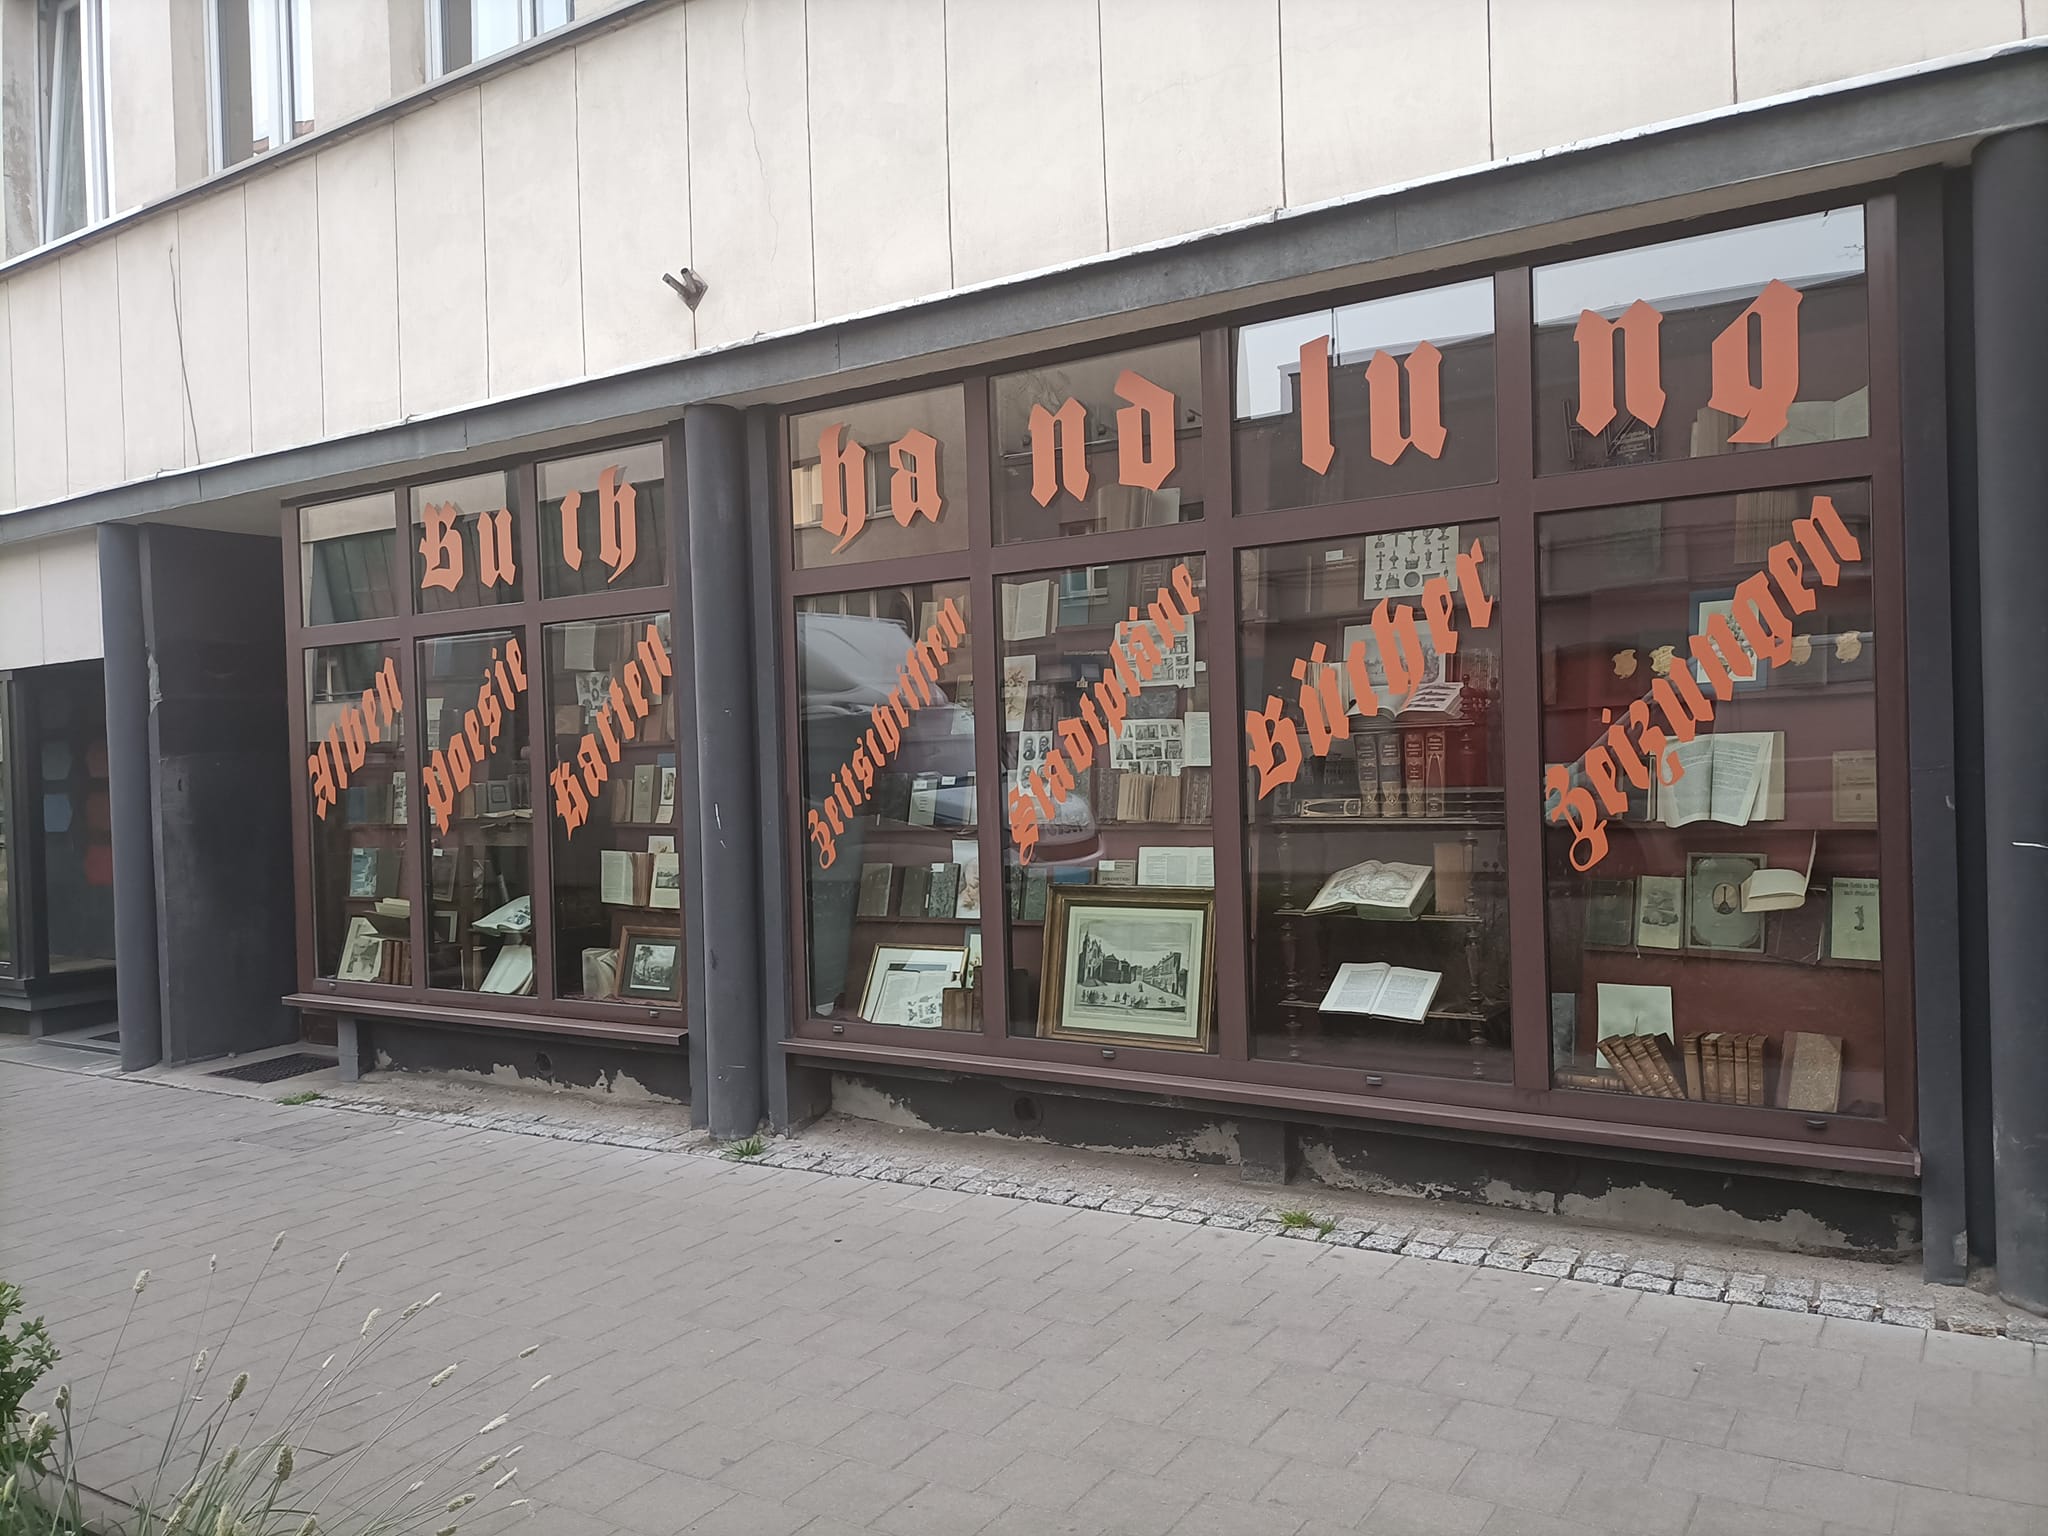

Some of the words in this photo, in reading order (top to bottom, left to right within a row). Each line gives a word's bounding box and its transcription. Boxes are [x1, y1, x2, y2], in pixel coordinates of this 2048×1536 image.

[419, 464, 638, 593] Buch
[307, 657, 403, 821] Alben
[422, 637, 528, 837] Poesie
[550, 623, 673, 840] Karten
[808, 597, 967, 870] Zeitschriften
[1008, 562, 1201, 866] Stadtpläne
[1245, 538, 1494, 801] Bücher
